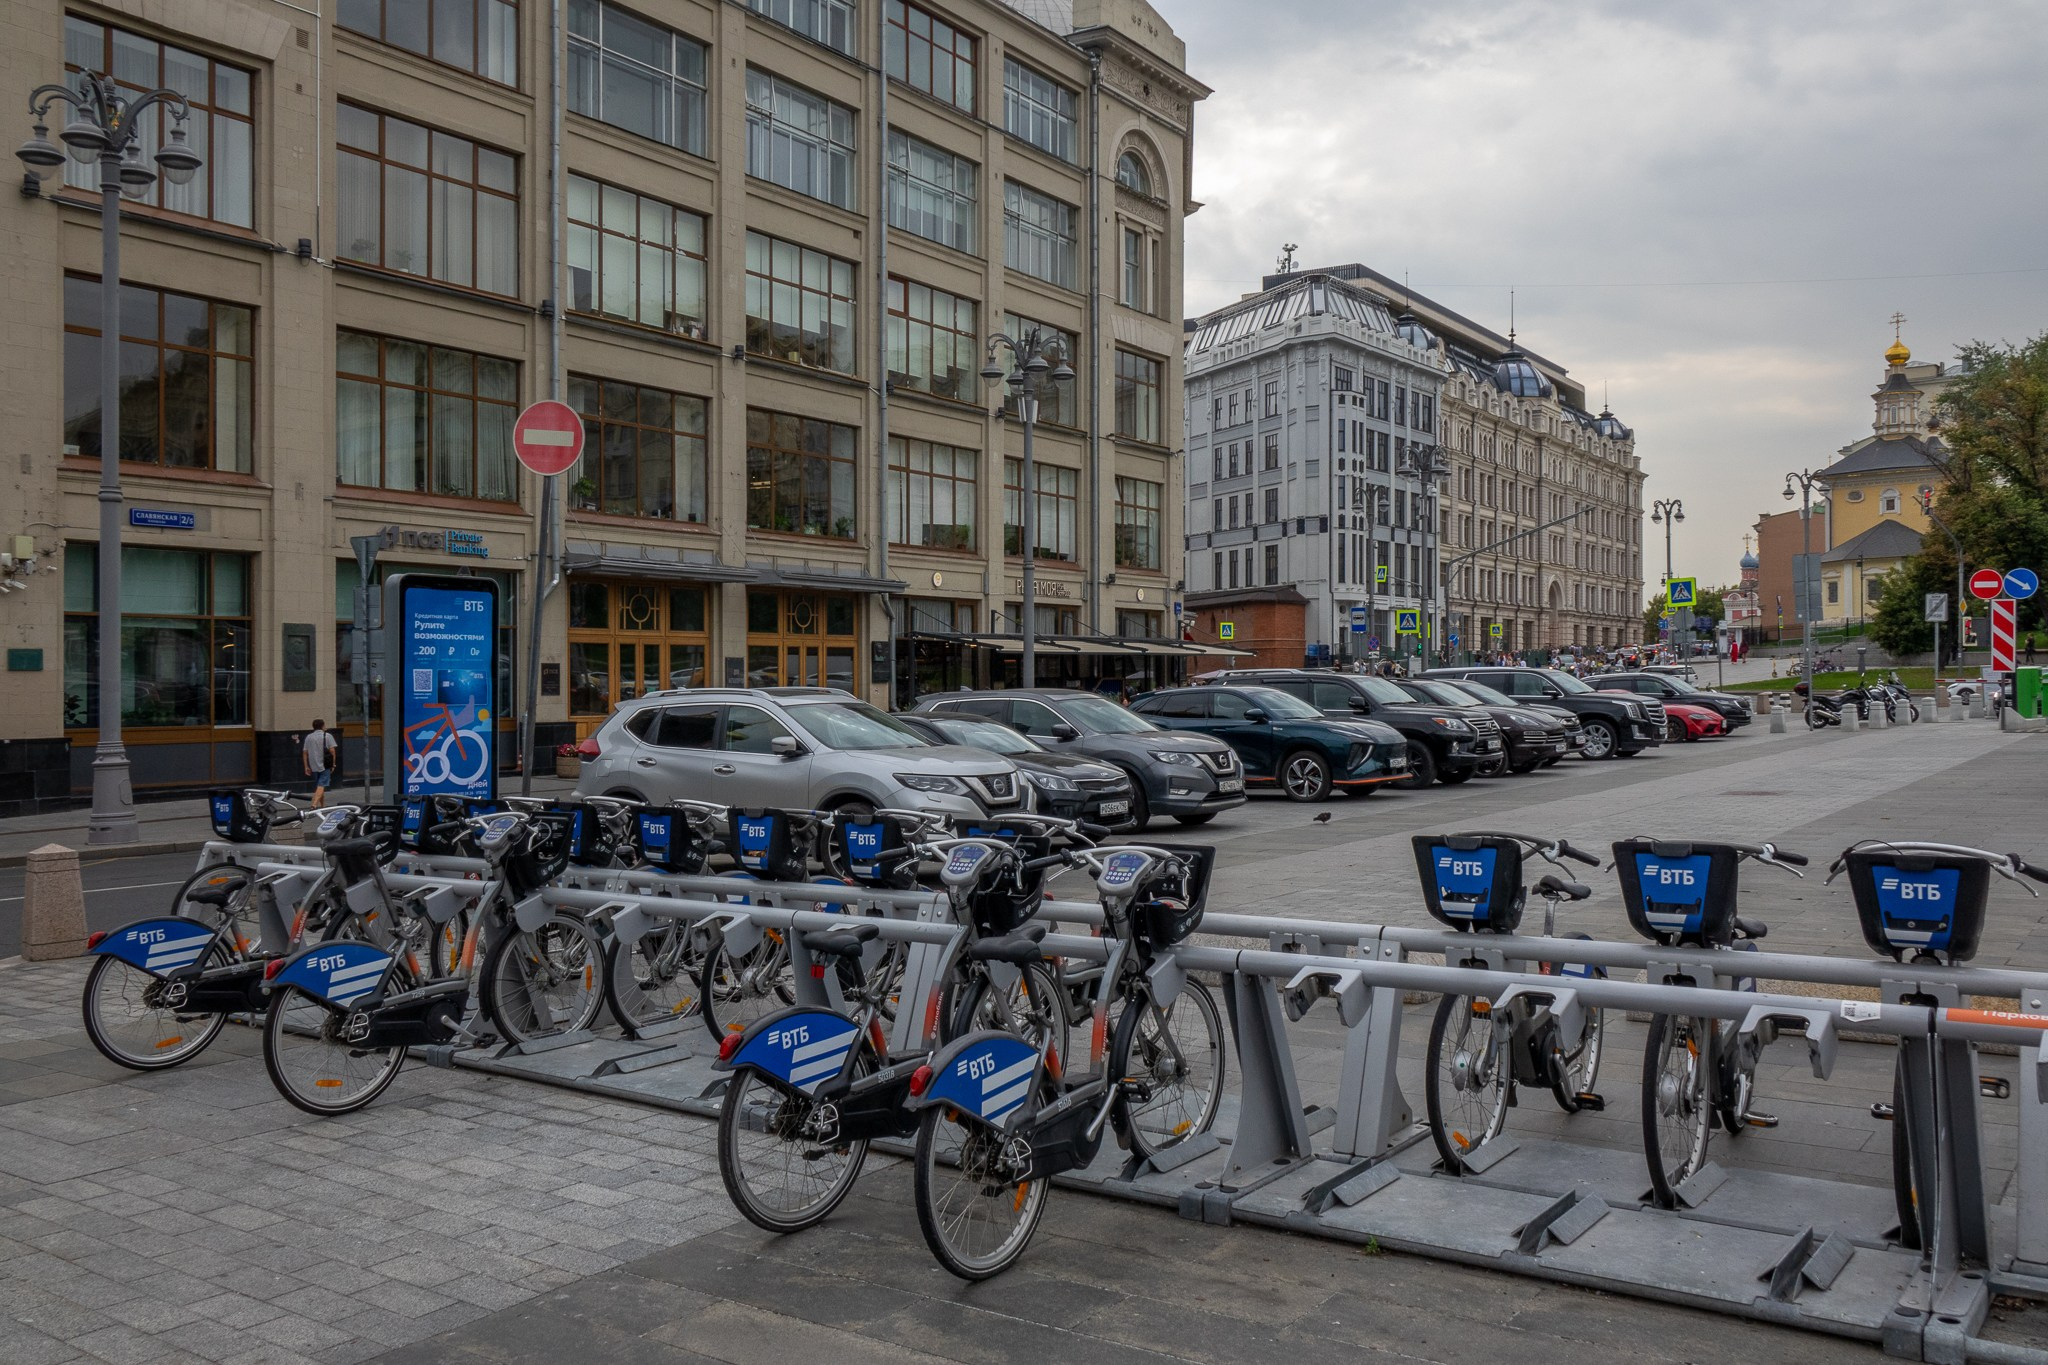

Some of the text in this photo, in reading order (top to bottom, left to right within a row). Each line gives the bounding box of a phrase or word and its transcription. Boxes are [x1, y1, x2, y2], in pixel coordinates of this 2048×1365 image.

[136, 512, 178, 521] СЛАВЯНСКАЯ
[403, 530, 443, 549] ПСБ
[451, 529, 484, 542] Private
[451, 543, 489, 559] Banking
[1040, 581, 1057, 596] МОЯ
[464, 600, 484, 612] ВТБ
[414, 612, 443, 620] Кредитная
[414, 620, 446, 630] Рулите
[414, 632, 485, 641] возможностями
[408, 729, 489, 785] 200
[408, 784, 420, 793] до
[468, 779, 488, 789] дней
[650, 823, 665, 835] ВТБ
[749, 826, 766, 838] ВТБ
[858, 834, 876, 845] ВТБ
[1453, 861, 1483, 876] ВТБ
[1660, 869, 1695, 885] ВТБ
[1901, 883, 1941, 900] ВТБ
[139, 929, 166, 944] ВТБ
[319, 954, 346, 972] ВТБ
[932, 991, 944, 1031] Велобайк
[781, 1025, 810, 1049] ВТБ
[969, 1052, 995, 1080] ВТБ
